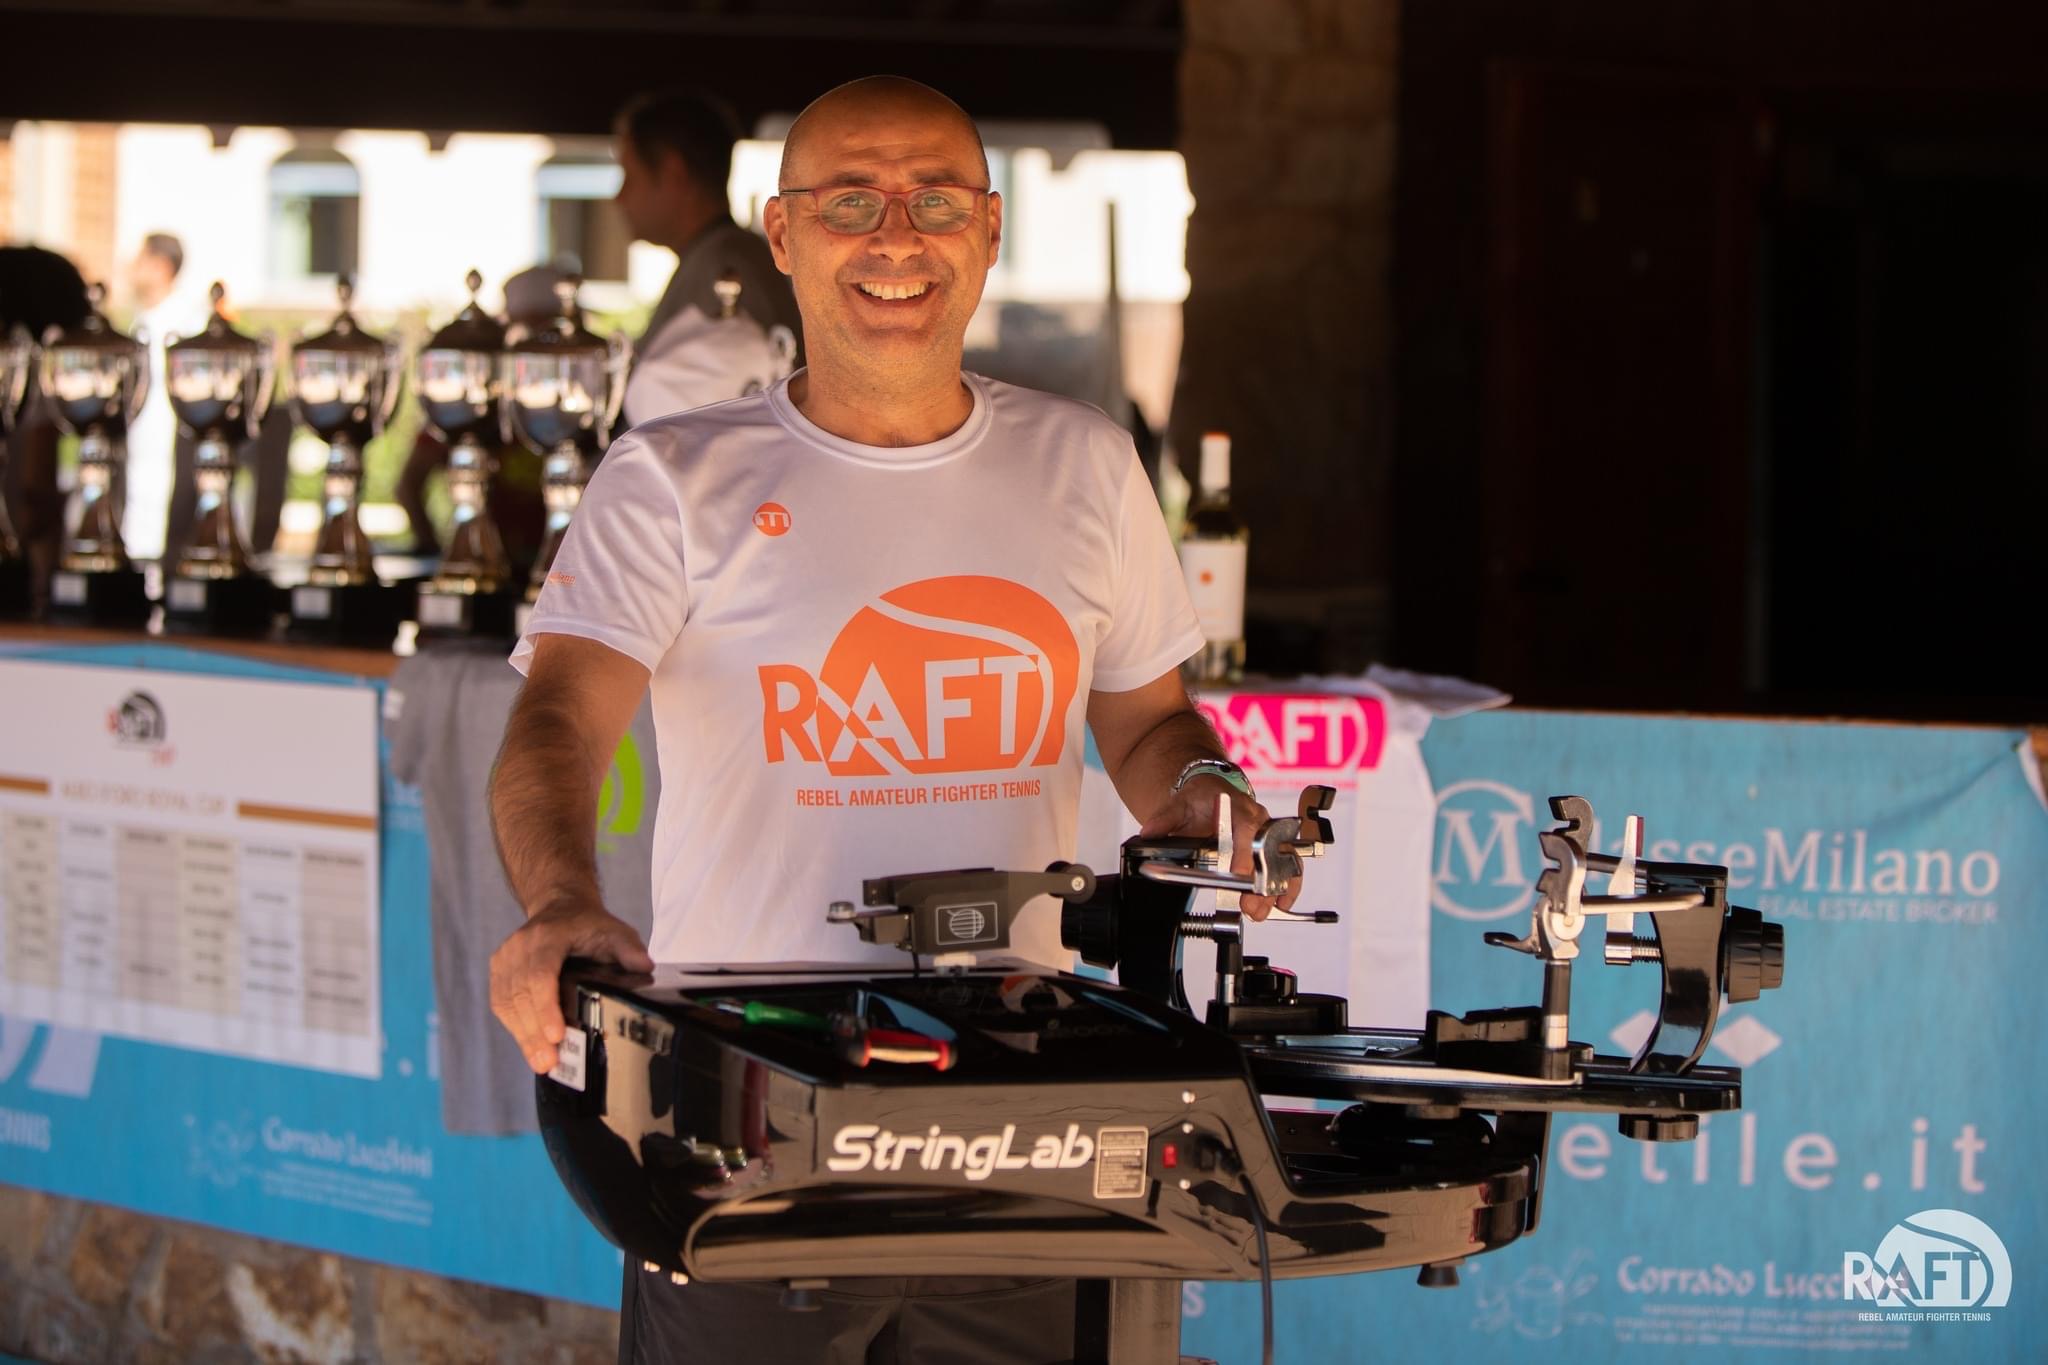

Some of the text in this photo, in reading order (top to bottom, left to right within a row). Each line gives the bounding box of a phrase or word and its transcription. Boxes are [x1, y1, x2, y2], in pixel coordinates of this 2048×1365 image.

[758, 654, 1039, 764] RAFT
[796, 779, 1041, 807] REBEL AMATEUR FIGHTER TENNIS
[1818, 899, 1899, 922] ESTATE
[826, 1123, 1094, 1181] StringLab
[1557, 1112, 1987, 1193] etile.it
[1617, 1255, 1756, 1299] Corrado
